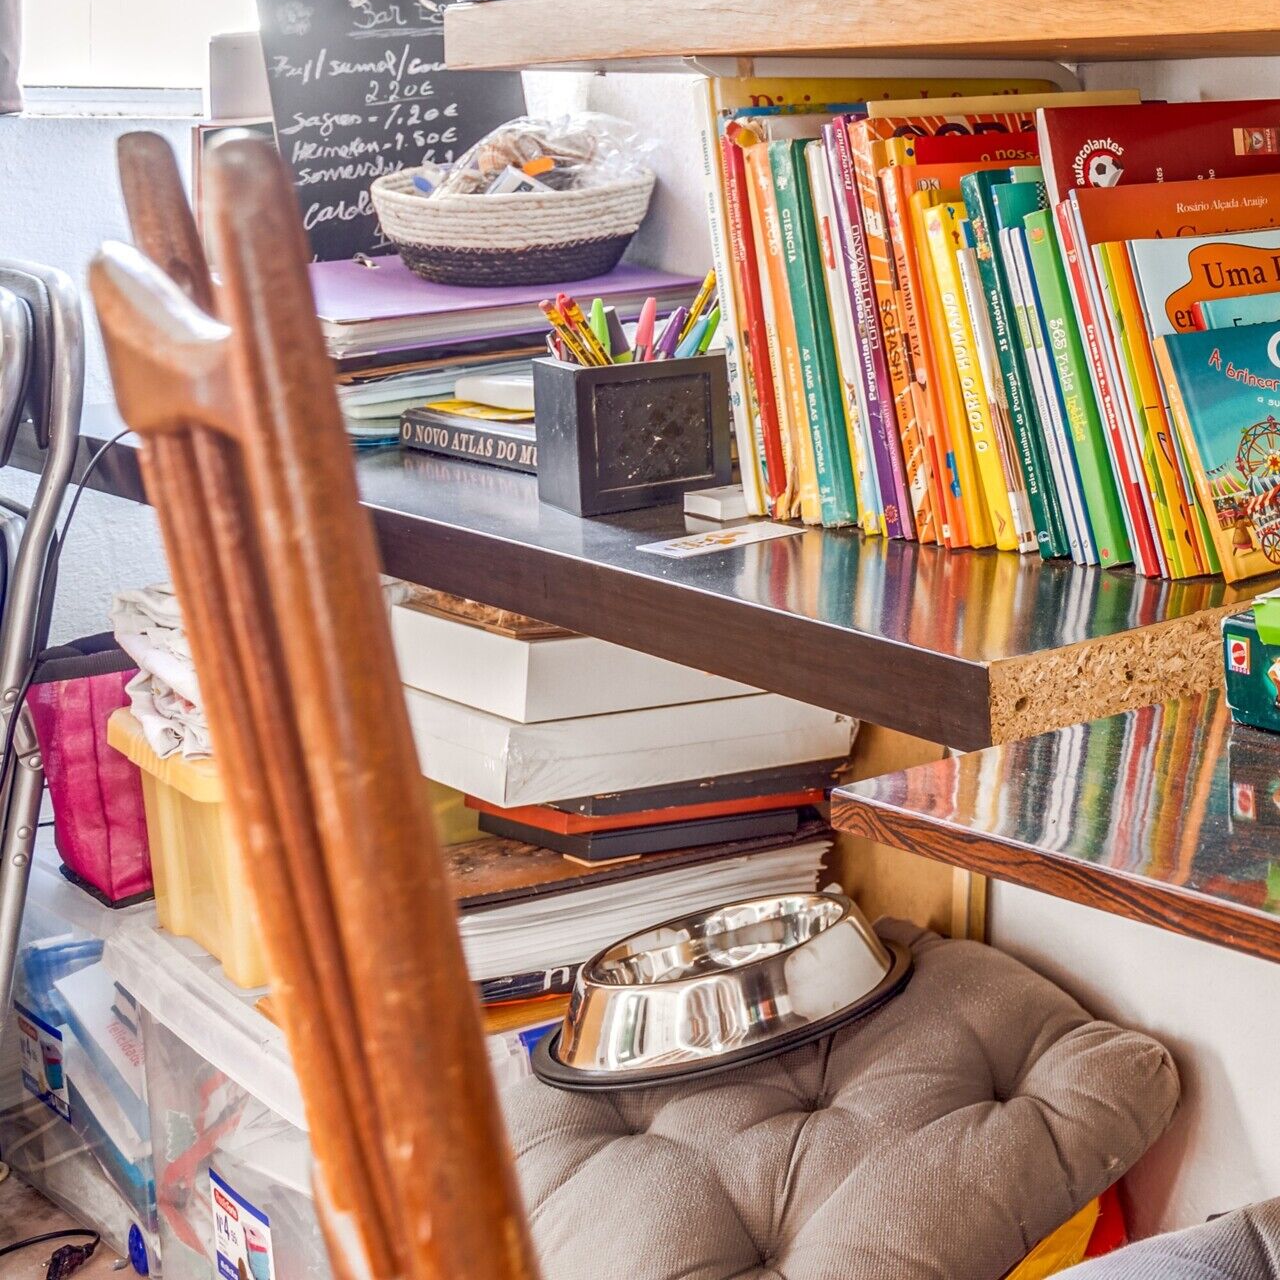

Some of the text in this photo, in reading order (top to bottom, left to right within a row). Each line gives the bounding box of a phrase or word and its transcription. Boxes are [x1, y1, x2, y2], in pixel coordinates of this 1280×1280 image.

[353, 2, 407, 28] Bar
[1071, 137, 1125, 186] autocolantes
[1176, 195, 1269, 214] Rosário Alçada Araújo
[851, 224, 872, 297] HUMANO
[1201, 261, 1268, 289] Uma
[943, 291, 970, 370] HUMANO
[991, 288, 1010, 352] 35 histórias
[1050, 317, 1068, 351] 365
[1086, 324, 1096, 339] Era
[1090, 340, 1101, 360] uma
[1208, 347, 1223, 371] A
[802, 348, 819, 421] AS MAIS BELAS
[862, 338, 877, 402] Perguntas
[1055, 352, 1074, 393] Piadas
[962, 376, 985, 434] CORPO
[1008, 372, 1023, 413] Portugal
[1257, 396, 1265, 404] a
[1102, 395, 1117, 431] Benfica
[402, 422, 517, 461] O NOVO ATLAS DO
[975, 440, 989, 452] O
[1018, 427, 1032, 463] Rainhas
[1030, 478, 1038, 495] Reis
